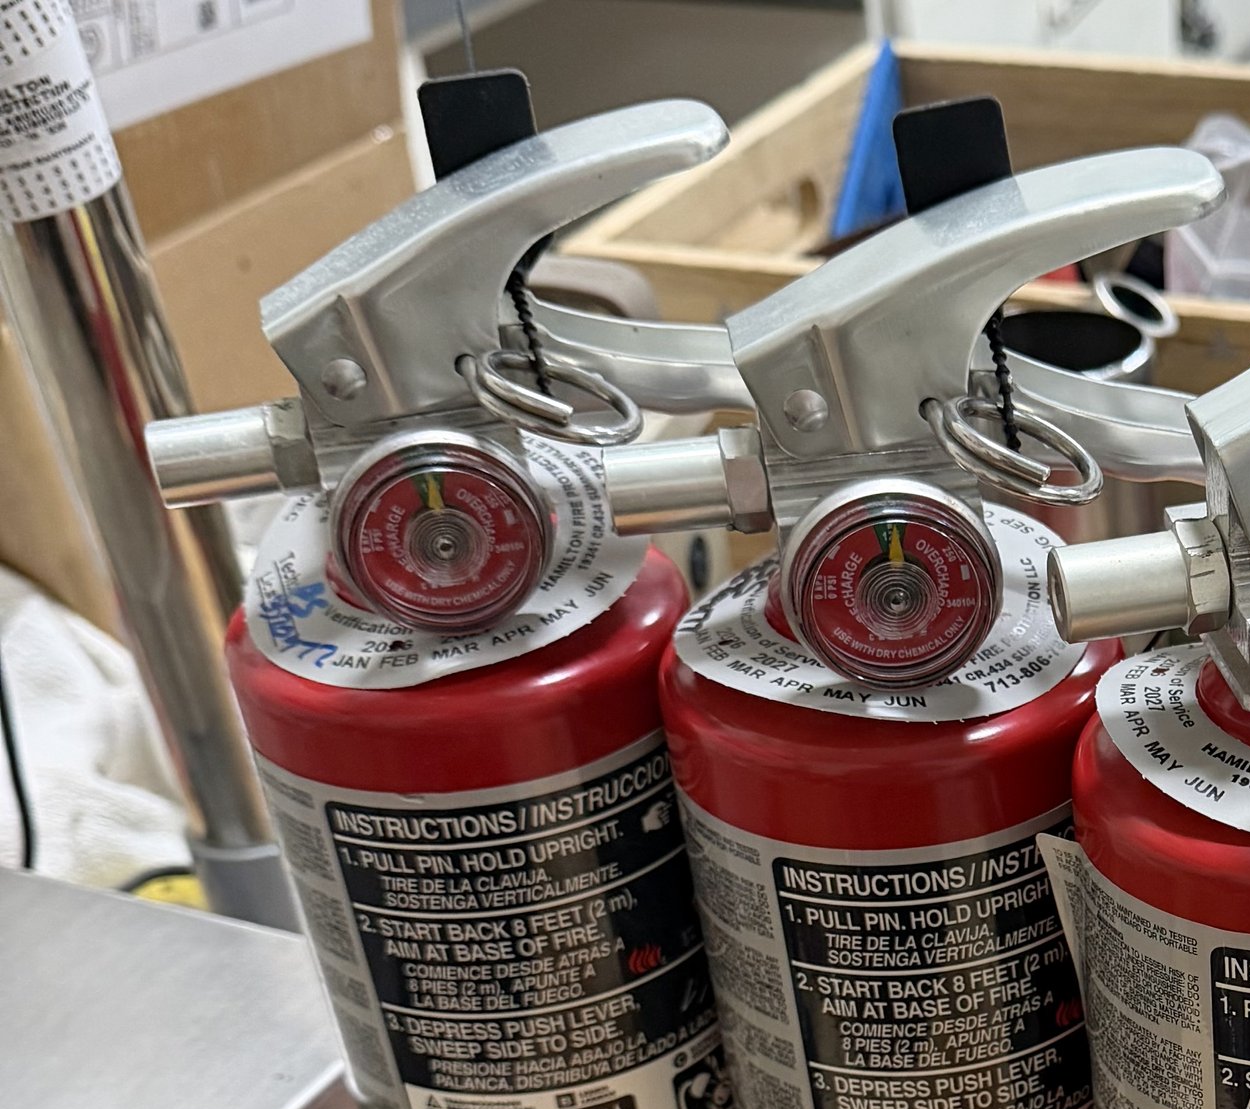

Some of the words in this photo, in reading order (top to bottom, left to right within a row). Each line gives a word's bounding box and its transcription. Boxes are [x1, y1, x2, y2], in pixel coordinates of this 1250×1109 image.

[541, 530, 585, 592] HAMILTON
[584, 572, 614, 598] JUN
[324, 605, 414, 635] Verification
[333, 654, 369, 669] JAN
[379, 653, 419, 667] FEB
[431, 642, 479, 660] MAR
[491, 626, 536, 646] APR
[540, 600, 580, 627] MAY
[759, 638, 774, 650] of
[898, 637, 947, 659] CHEMICAL
[944, 617, 966, 640] ONLY
[706, 644, 729, 662] FEB
[727, 659, 767, 680] MAR
[770, 677, 814, 693] APR
[823, 687, 872, 703] MAY
[884, 695, 927, 708] JUN
[750, 652, 800, 673] 2027
[965, 660, 1013, 683] CR.434
[1124, 665, 1146, 680] FEB
[1120, 682, 1134, 705] MAR
[1169, 678, 1184, 686] of
[1144, 687, 1166, 711] 2027
[1168, 689, 1195, 728] Service
[1124, 709, 1150, 738] APR
[1145, 741, 1184, 772] MAY
[1185, 776, 1225, 802] JUN
[334, 809, 518, 840] INSTRUCTIONS
[340, 847, 359, 867] 1.
[361, 849, 416, 874] PULL
[419, 854, 461, 874] PIN.
[465, 847, 526, 872] HOLD
[532, 819, 624, 864] UPRIGHT.
[783, 866, 966, 898] INSTRUCTIONS
[785, 904, 801, 924] 1.
[806, 909, 861, 932] PULL
[865, 913, 906, 932] PIN.
[910, 904, 971, 929] HOLD
[1220, 996, 1236, 1016] 1.
